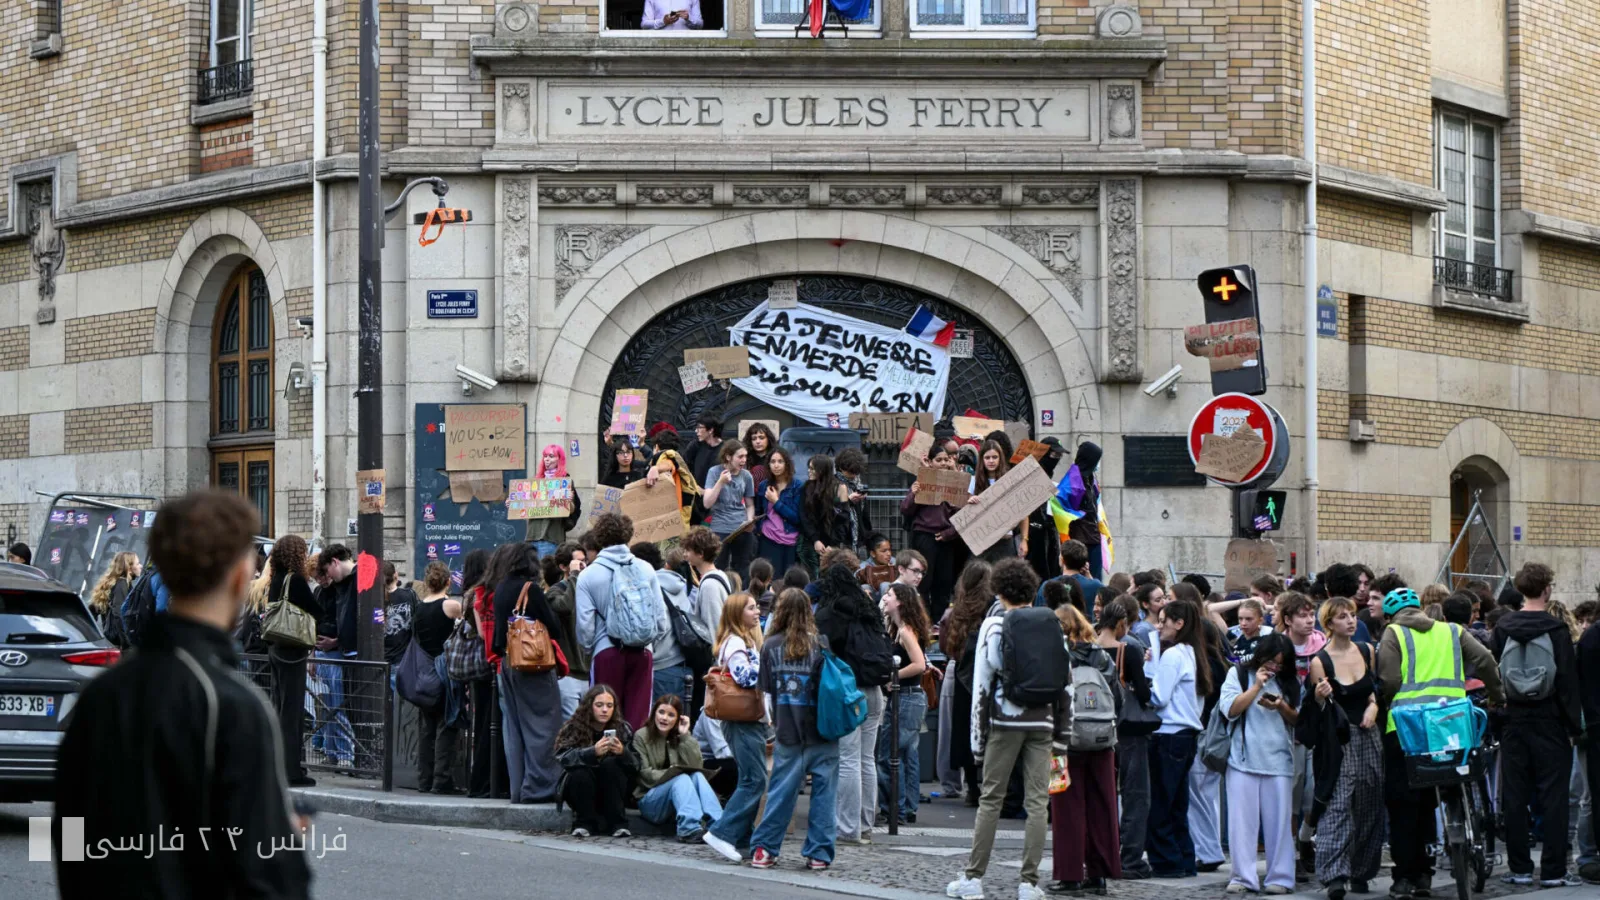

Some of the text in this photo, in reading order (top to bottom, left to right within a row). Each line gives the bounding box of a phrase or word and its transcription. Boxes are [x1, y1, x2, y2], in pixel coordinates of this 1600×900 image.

[577, 95, 1054, 127] LYCEE JULES FERRY
[751, 311, 790, 333] LA
[1209, 320, 1253, 337] LUTTE
[893, 391, 933, 413] RN
[448, 426, 487, 445] NOUS
[425, 523, 481, 532] Conseil régional
[425, 534, 442, 542] Lycée
[458, 534, 474, 542] Ferry
